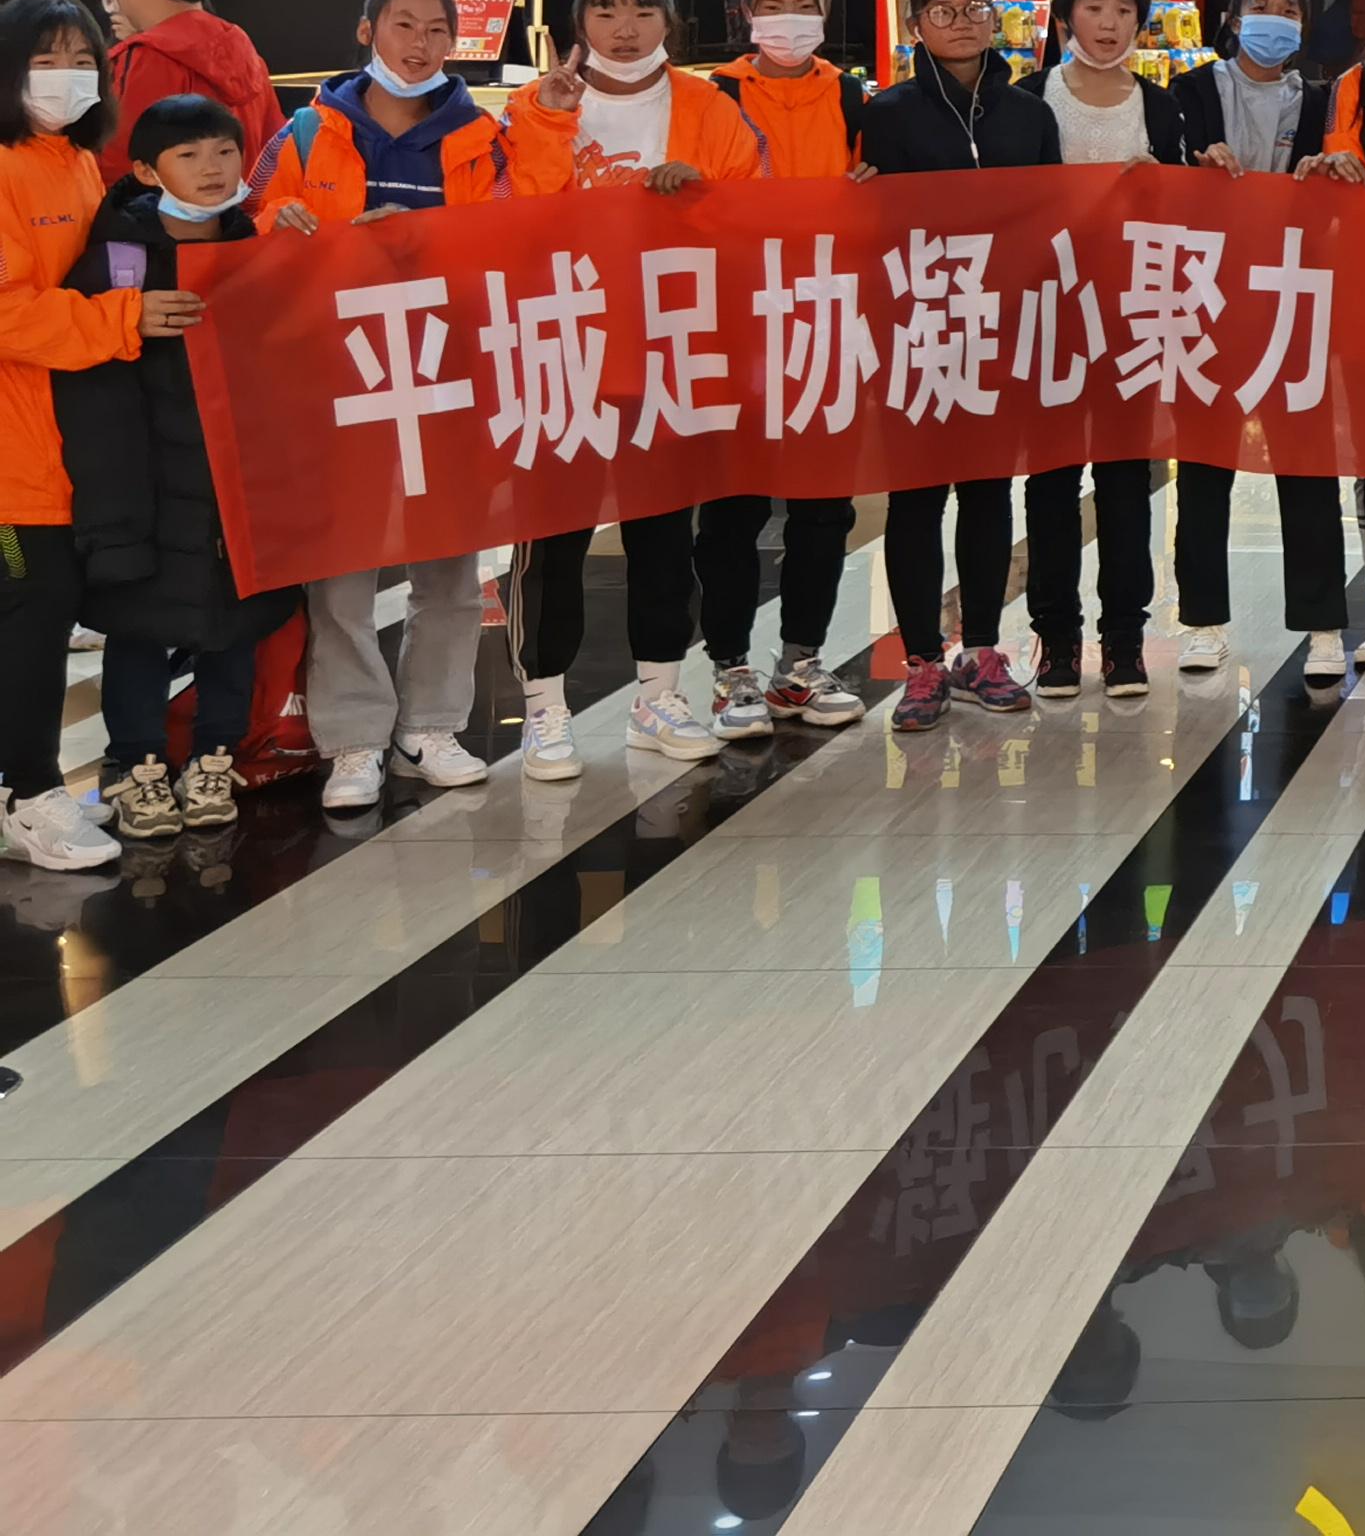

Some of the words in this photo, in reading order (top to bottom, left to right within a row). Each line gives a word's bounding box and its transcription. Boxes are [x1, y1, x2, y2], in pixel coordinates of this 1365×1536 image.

[334, 221, 1334, 496] 平城足协凝心聚力
